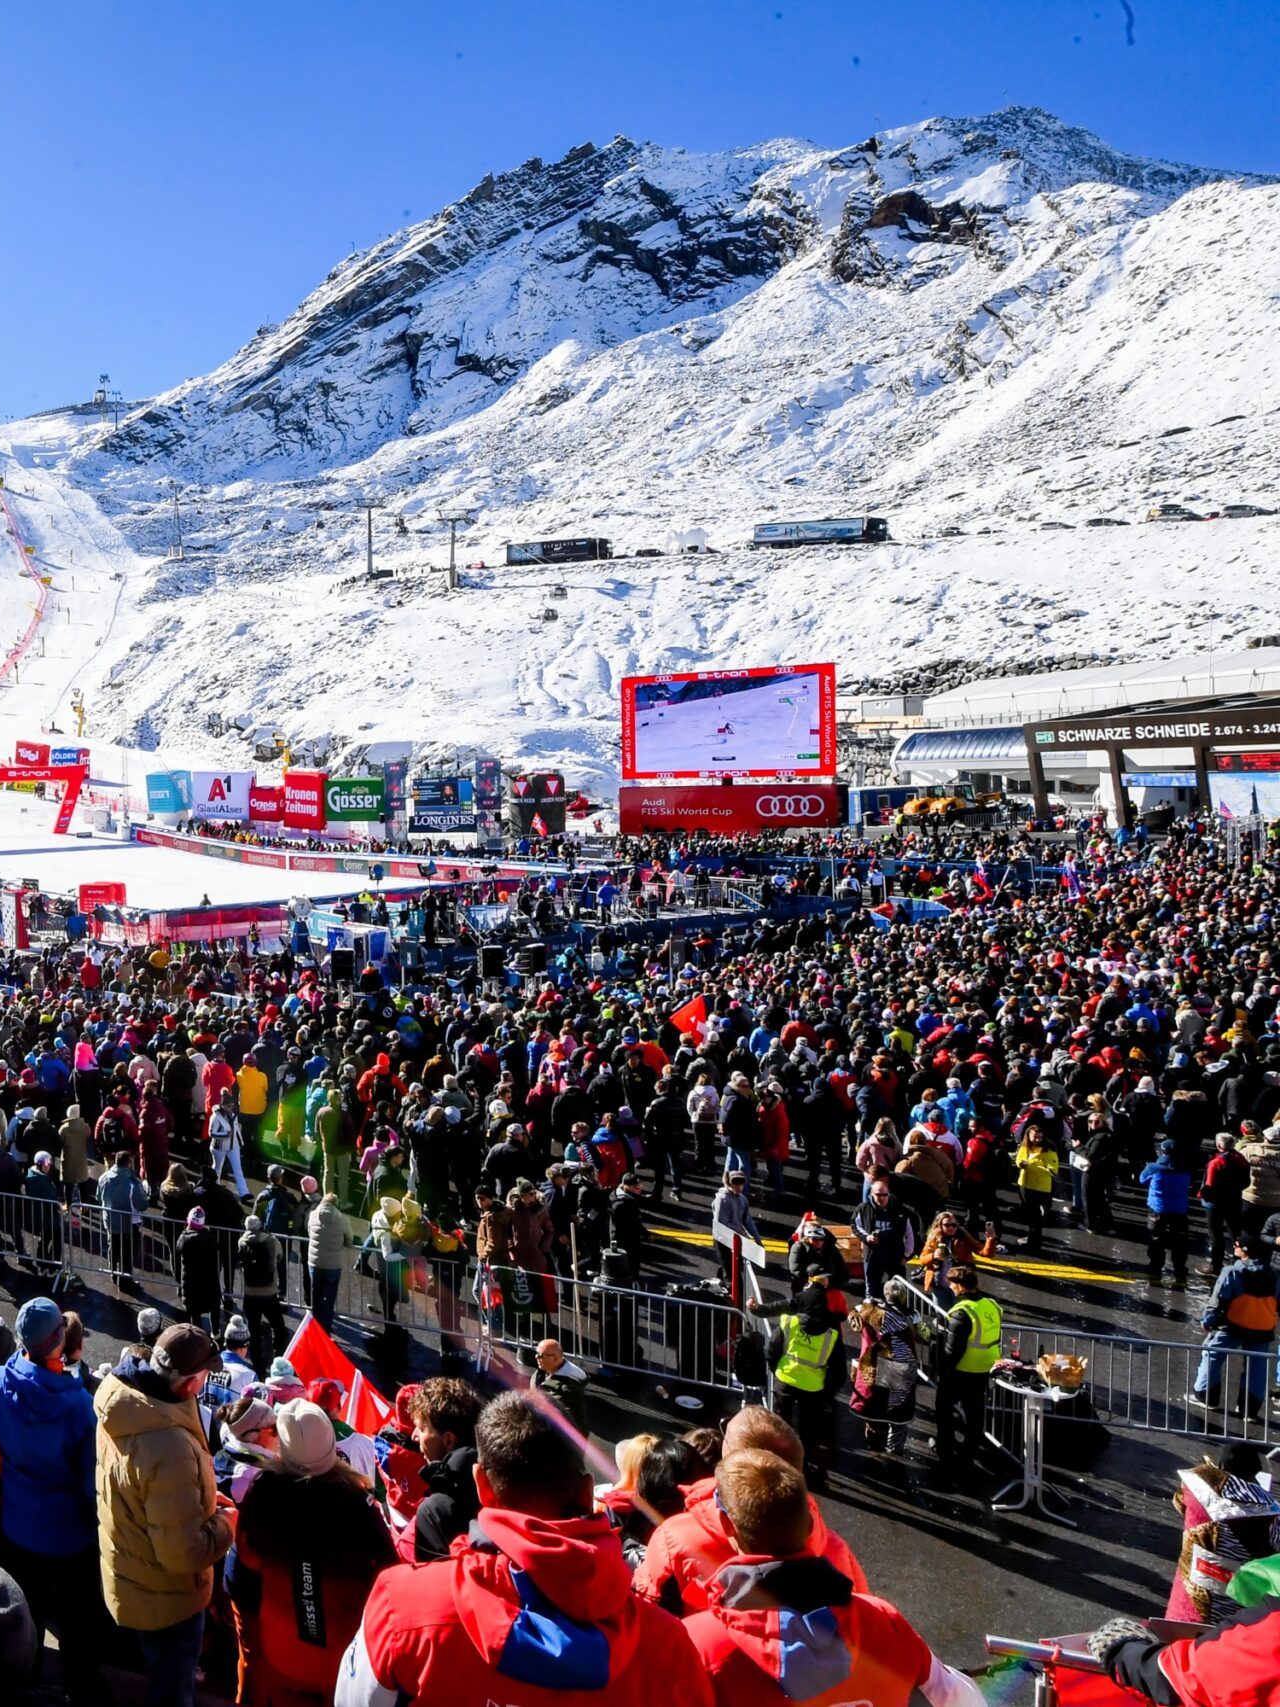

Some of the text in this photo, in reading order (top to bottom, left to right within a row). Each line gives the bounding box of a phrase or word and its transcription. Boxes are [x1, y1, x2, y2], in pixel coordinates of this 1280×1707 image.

[698, 670, 749, 680] e-tron
[824, 675, 832, 765] Audi FIS Ski World Cup
[1057, 726, 1132, 743] SCHWARZE
[1134, 722, 1211, 741] SCHNEIDE
[1214, 725, 1244, 736] 2.674
[698, 769, 750, 778] e-tron
[285, 786, 318, 801] Kronen
[327, 786, 381, 812] Gösser
[285, 800, 318, 817] Zeitung
[642, 798, 665, 806] Audi
[641, 807, 733, 817] FIS Ski World Cup
[413, 815, 475, 826] LONGINES
[302, 1562, 314, 1597] team
